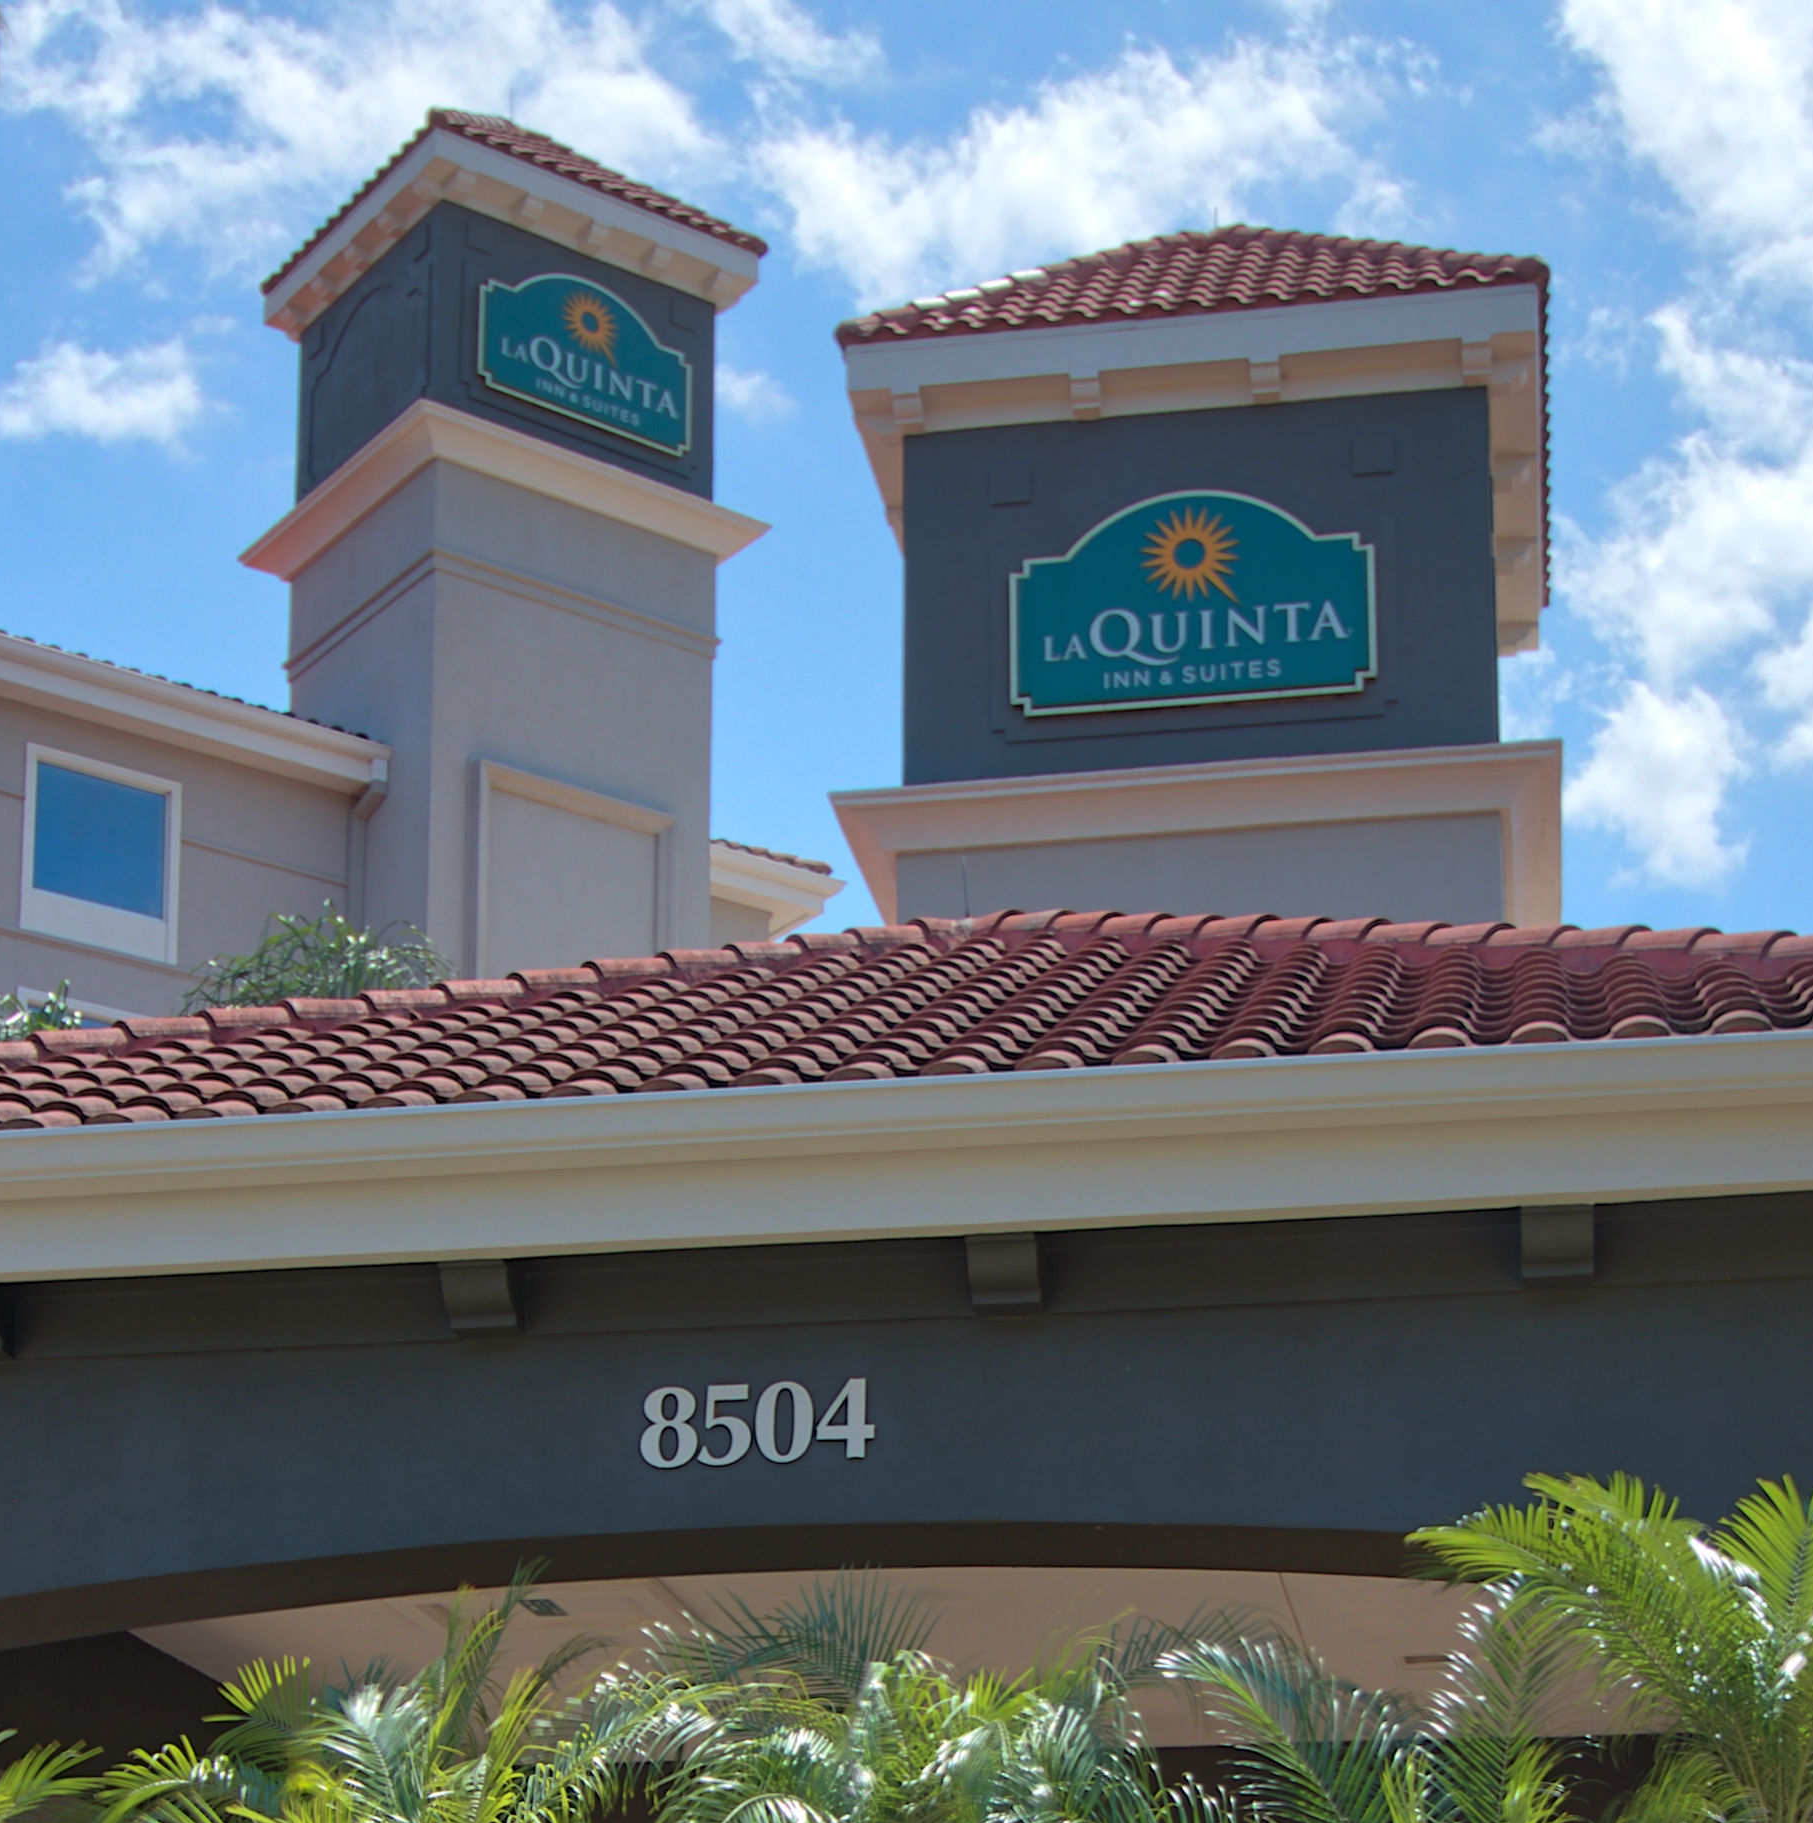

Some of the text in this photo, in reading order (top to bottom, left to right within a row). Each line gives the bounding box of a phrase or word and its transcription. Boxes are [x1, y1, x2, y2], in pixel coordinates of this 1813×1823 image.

[535, 377, 641, 427] INN & SUITES
[1103, 658, 1282, 690] INN & SUITES
[639, 1377, 876, 1470] 8504
